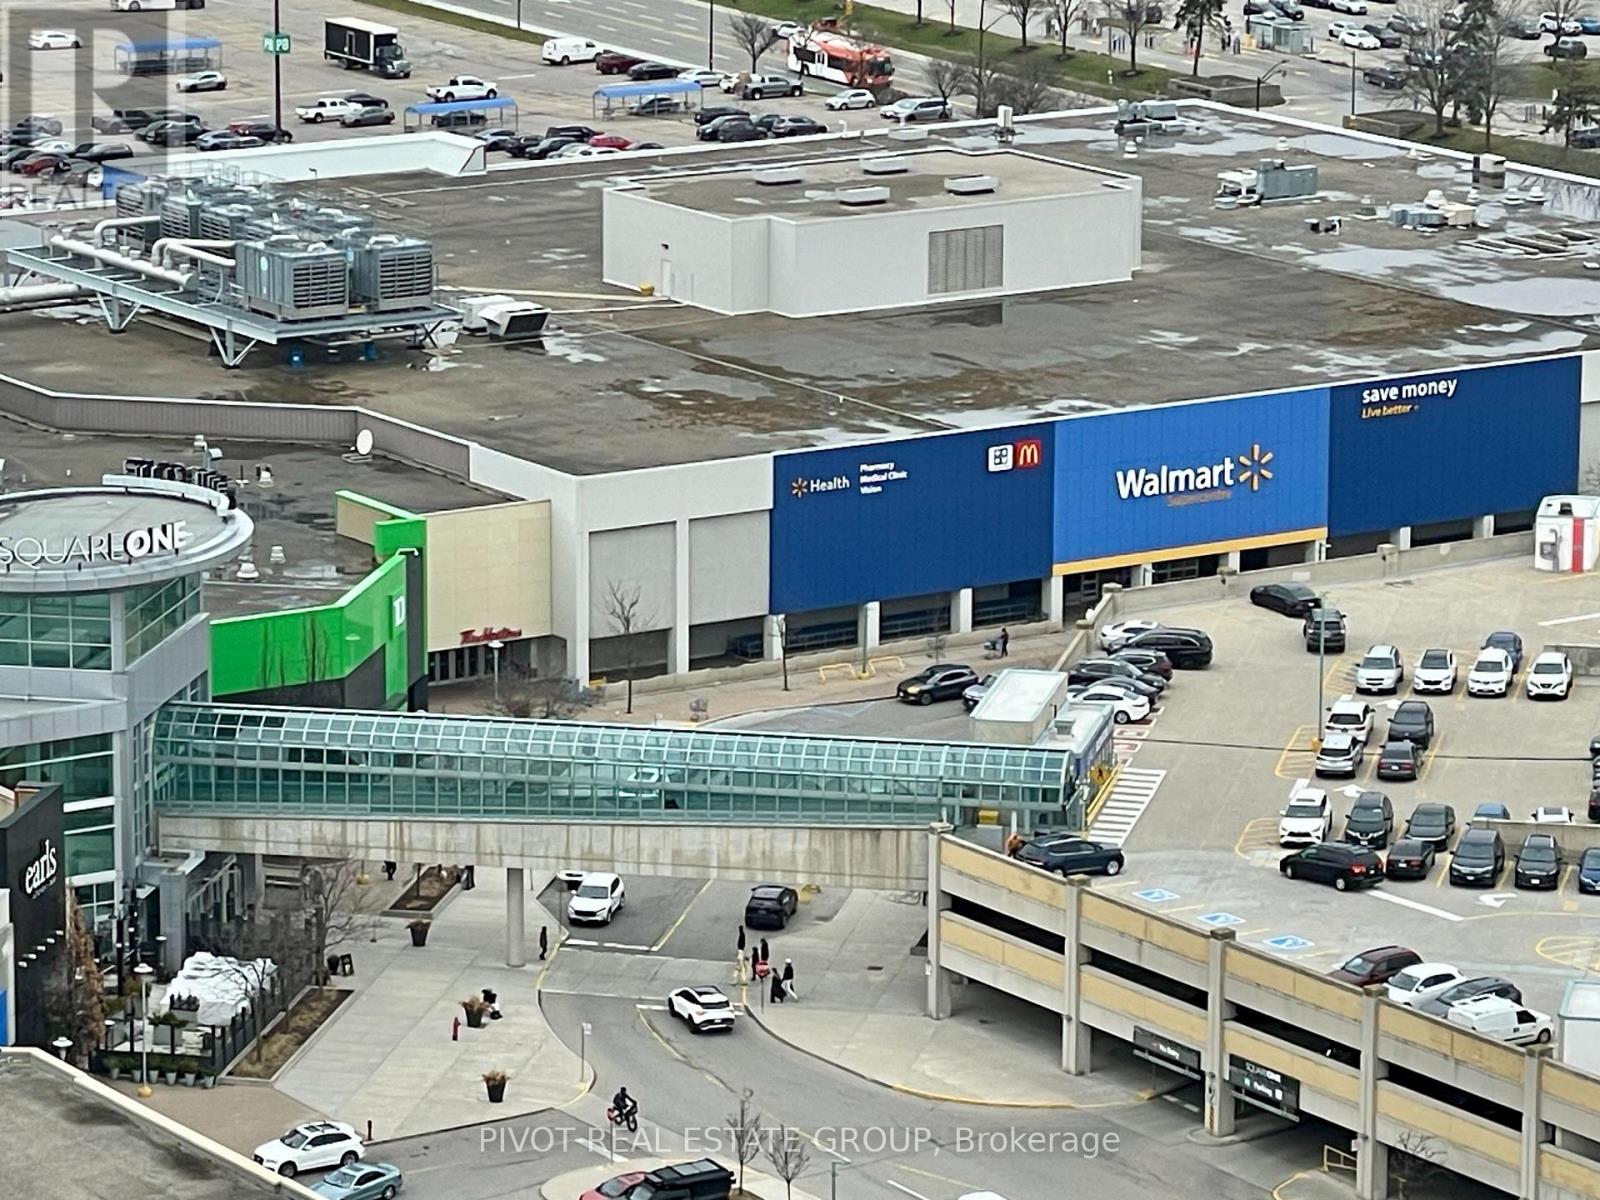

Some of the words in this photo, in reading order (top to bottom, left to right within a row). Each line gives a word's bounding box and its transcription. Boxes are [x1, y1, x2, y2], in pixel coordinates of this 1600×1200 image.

[1362, 386, 1399, 404] save
[1402, 378, 1457, 398] money
[1382, 404, 1413, 416] better
[810, 475, 850, 493] Health
[1116, 457, 1235, 499] Walmart
[25, 839, 57, 895] earls
